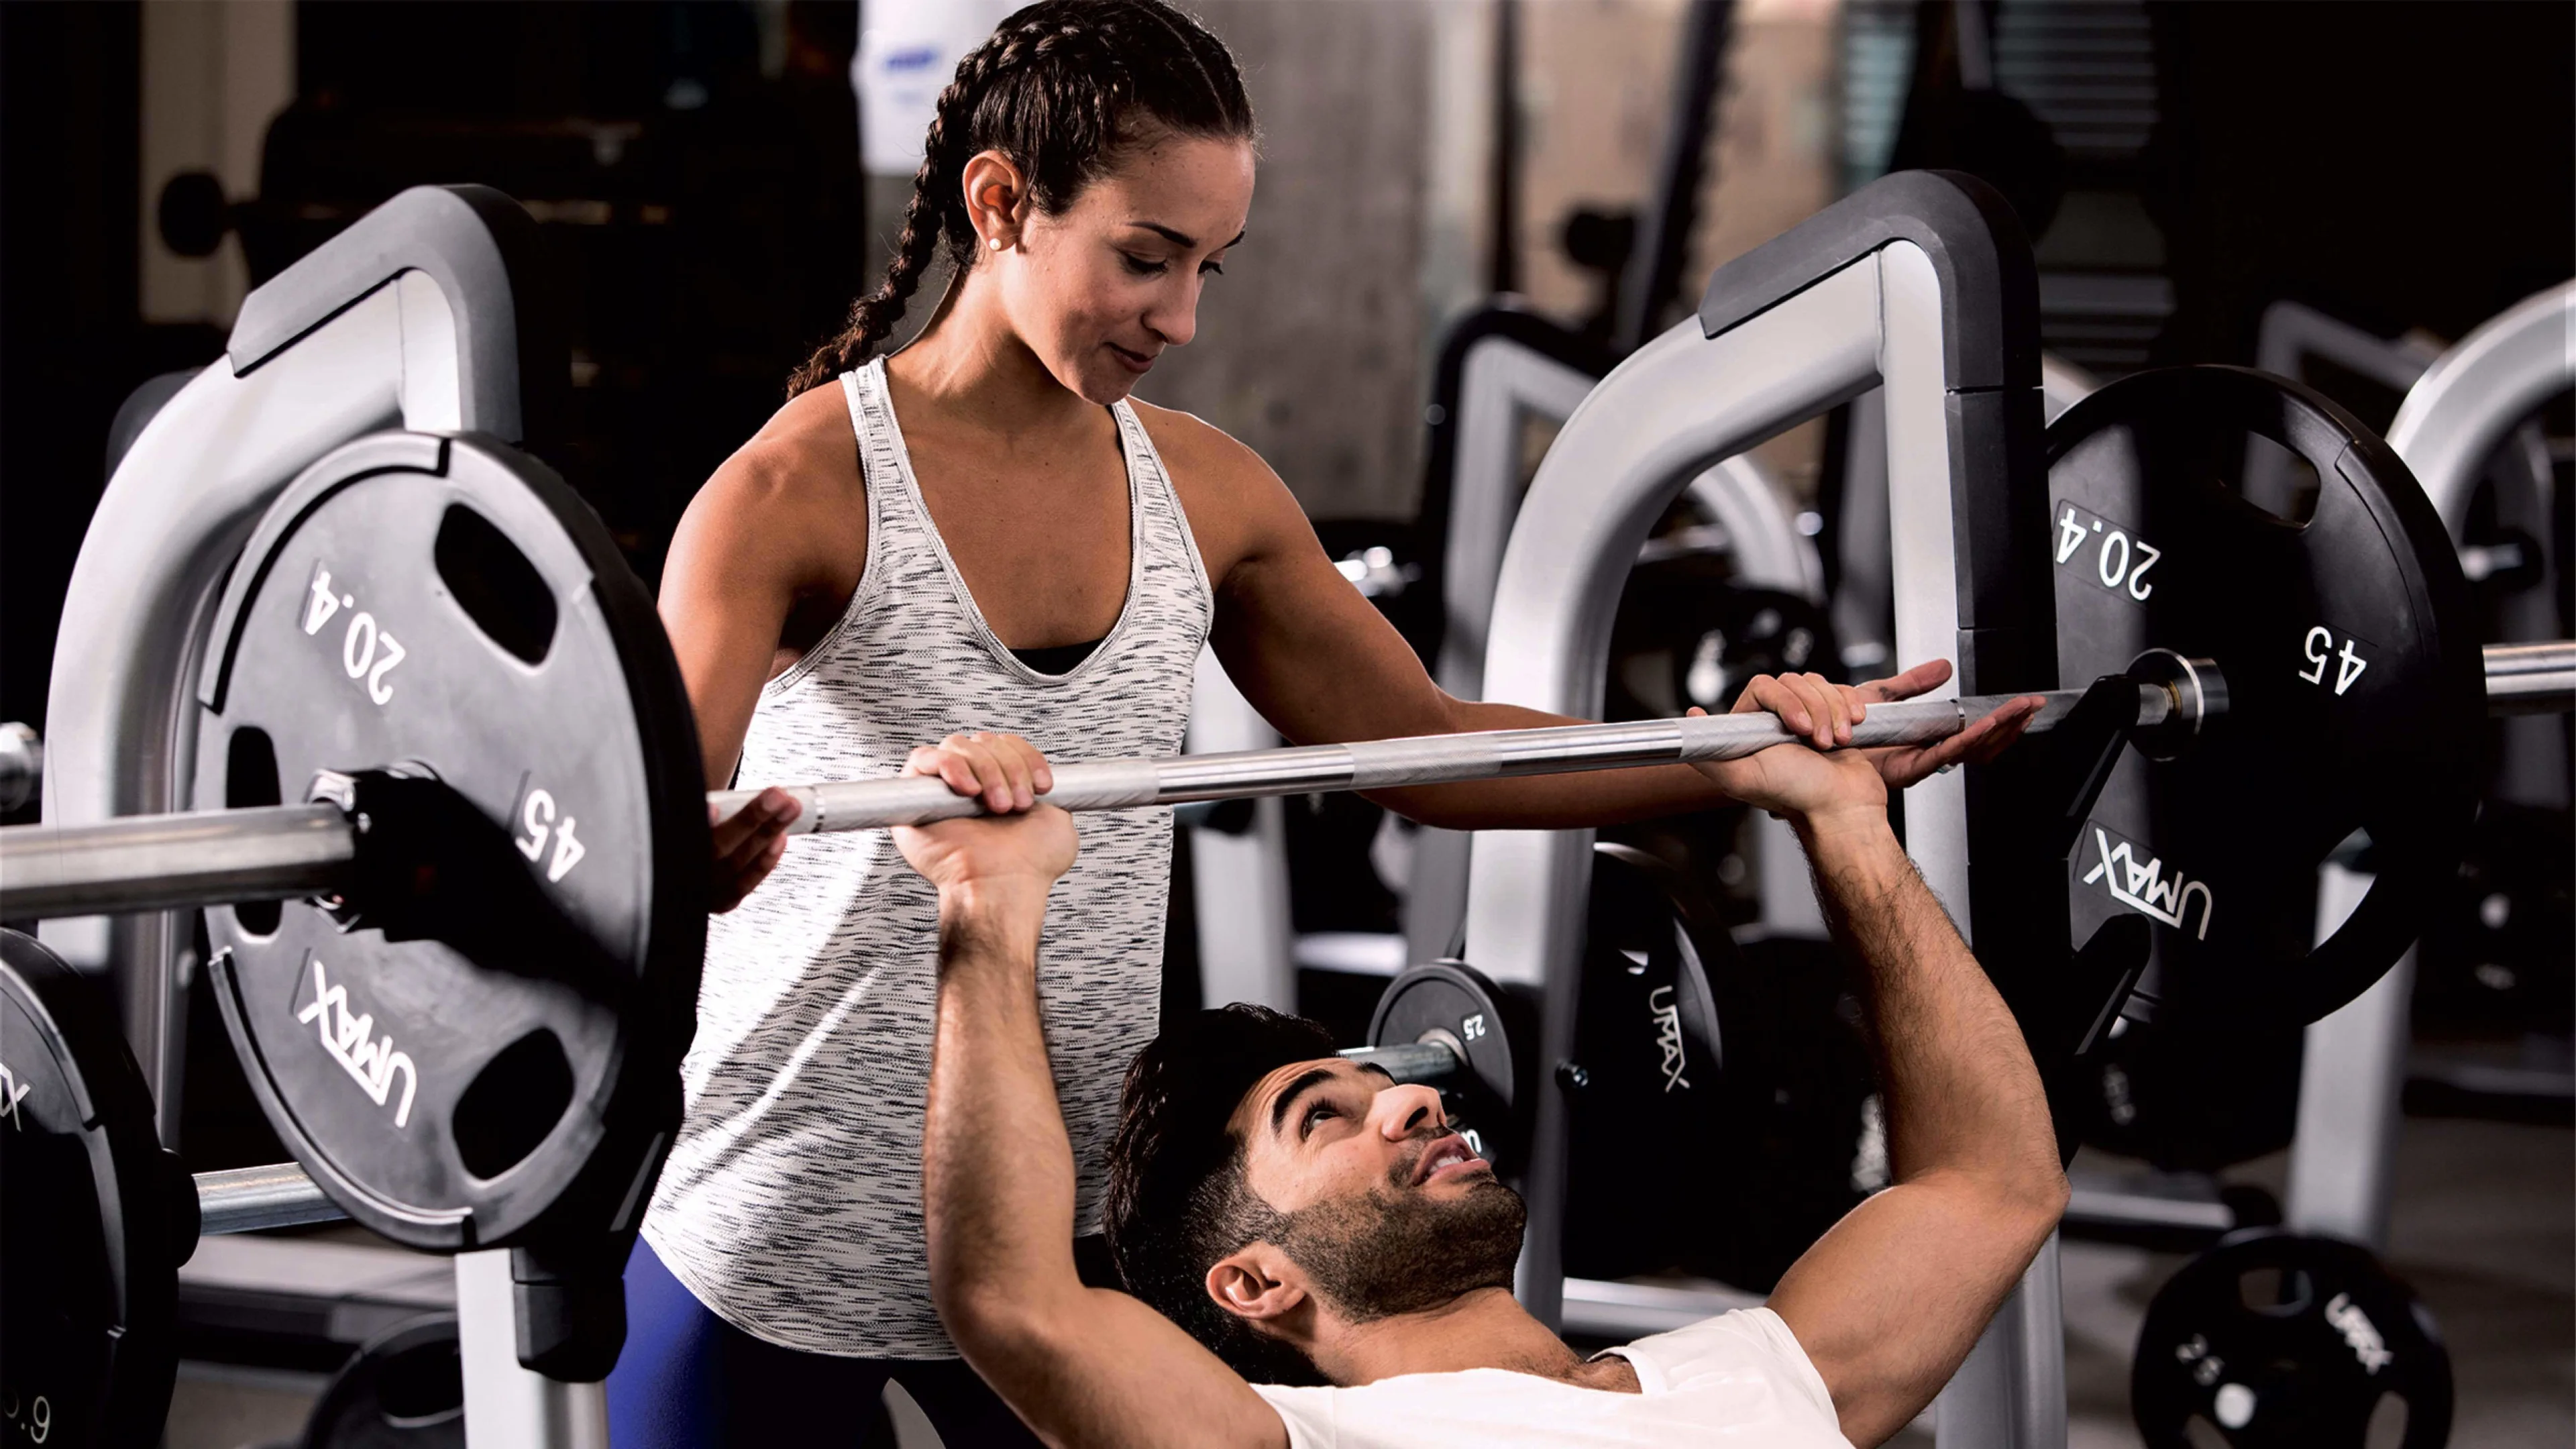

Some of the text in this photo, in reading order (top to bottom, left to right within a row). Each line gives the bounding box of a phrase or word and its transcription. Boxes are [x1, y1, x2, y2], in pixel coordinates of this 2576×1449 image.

[2055, 508, 2161, 601] 20.4
[304, 570, 406, 706] 20.4
[2298, 625, 2367, 696] 45
[515, 788, 586, 883] 45
[2083, 827, 2212, 941] UMAX
[297, 959, 417, 1128] UMAX
[1462, 1014, 1486, 1041] 25
[1648, 984, 1691, 1093] UMAX
